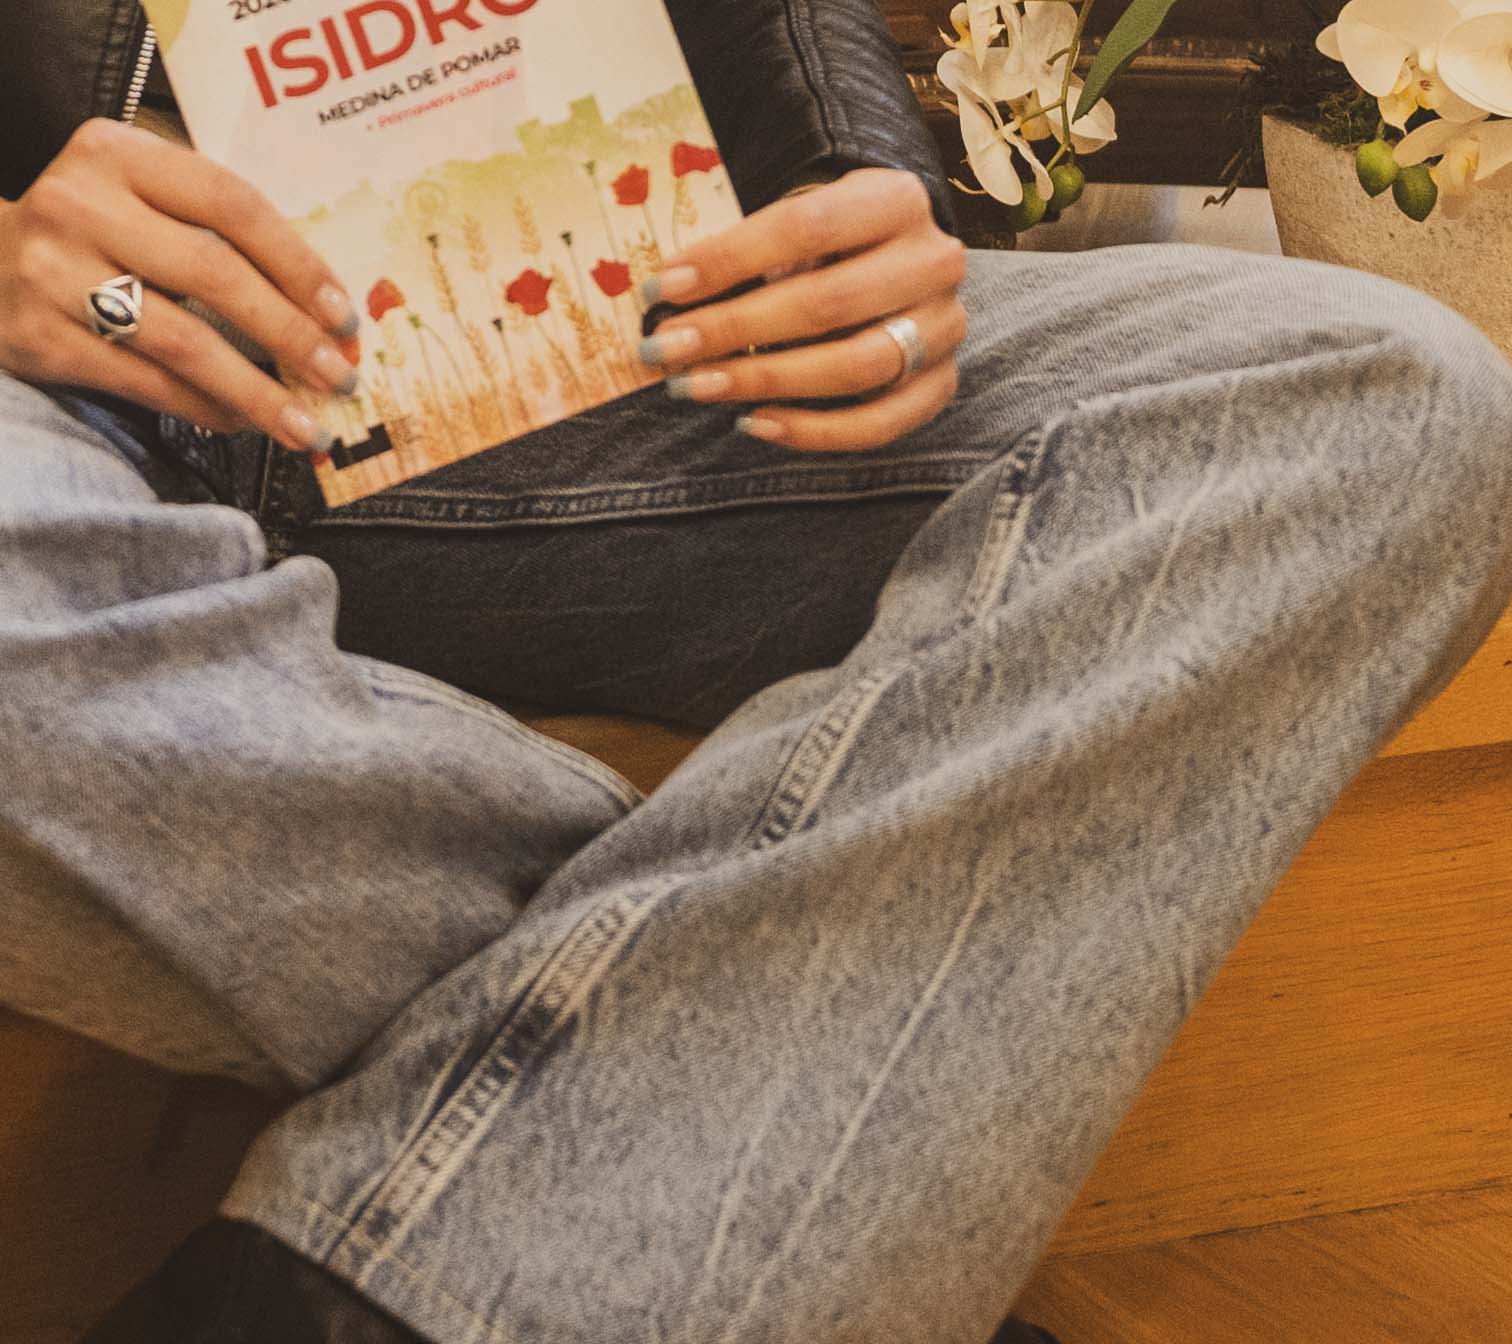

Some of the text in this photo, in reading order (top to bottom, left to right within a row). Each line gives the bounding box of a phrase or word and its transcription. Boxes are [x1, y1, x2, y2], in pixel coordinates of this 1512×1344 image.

[319, 36, 520, 124] MEDINA DE POMAR
